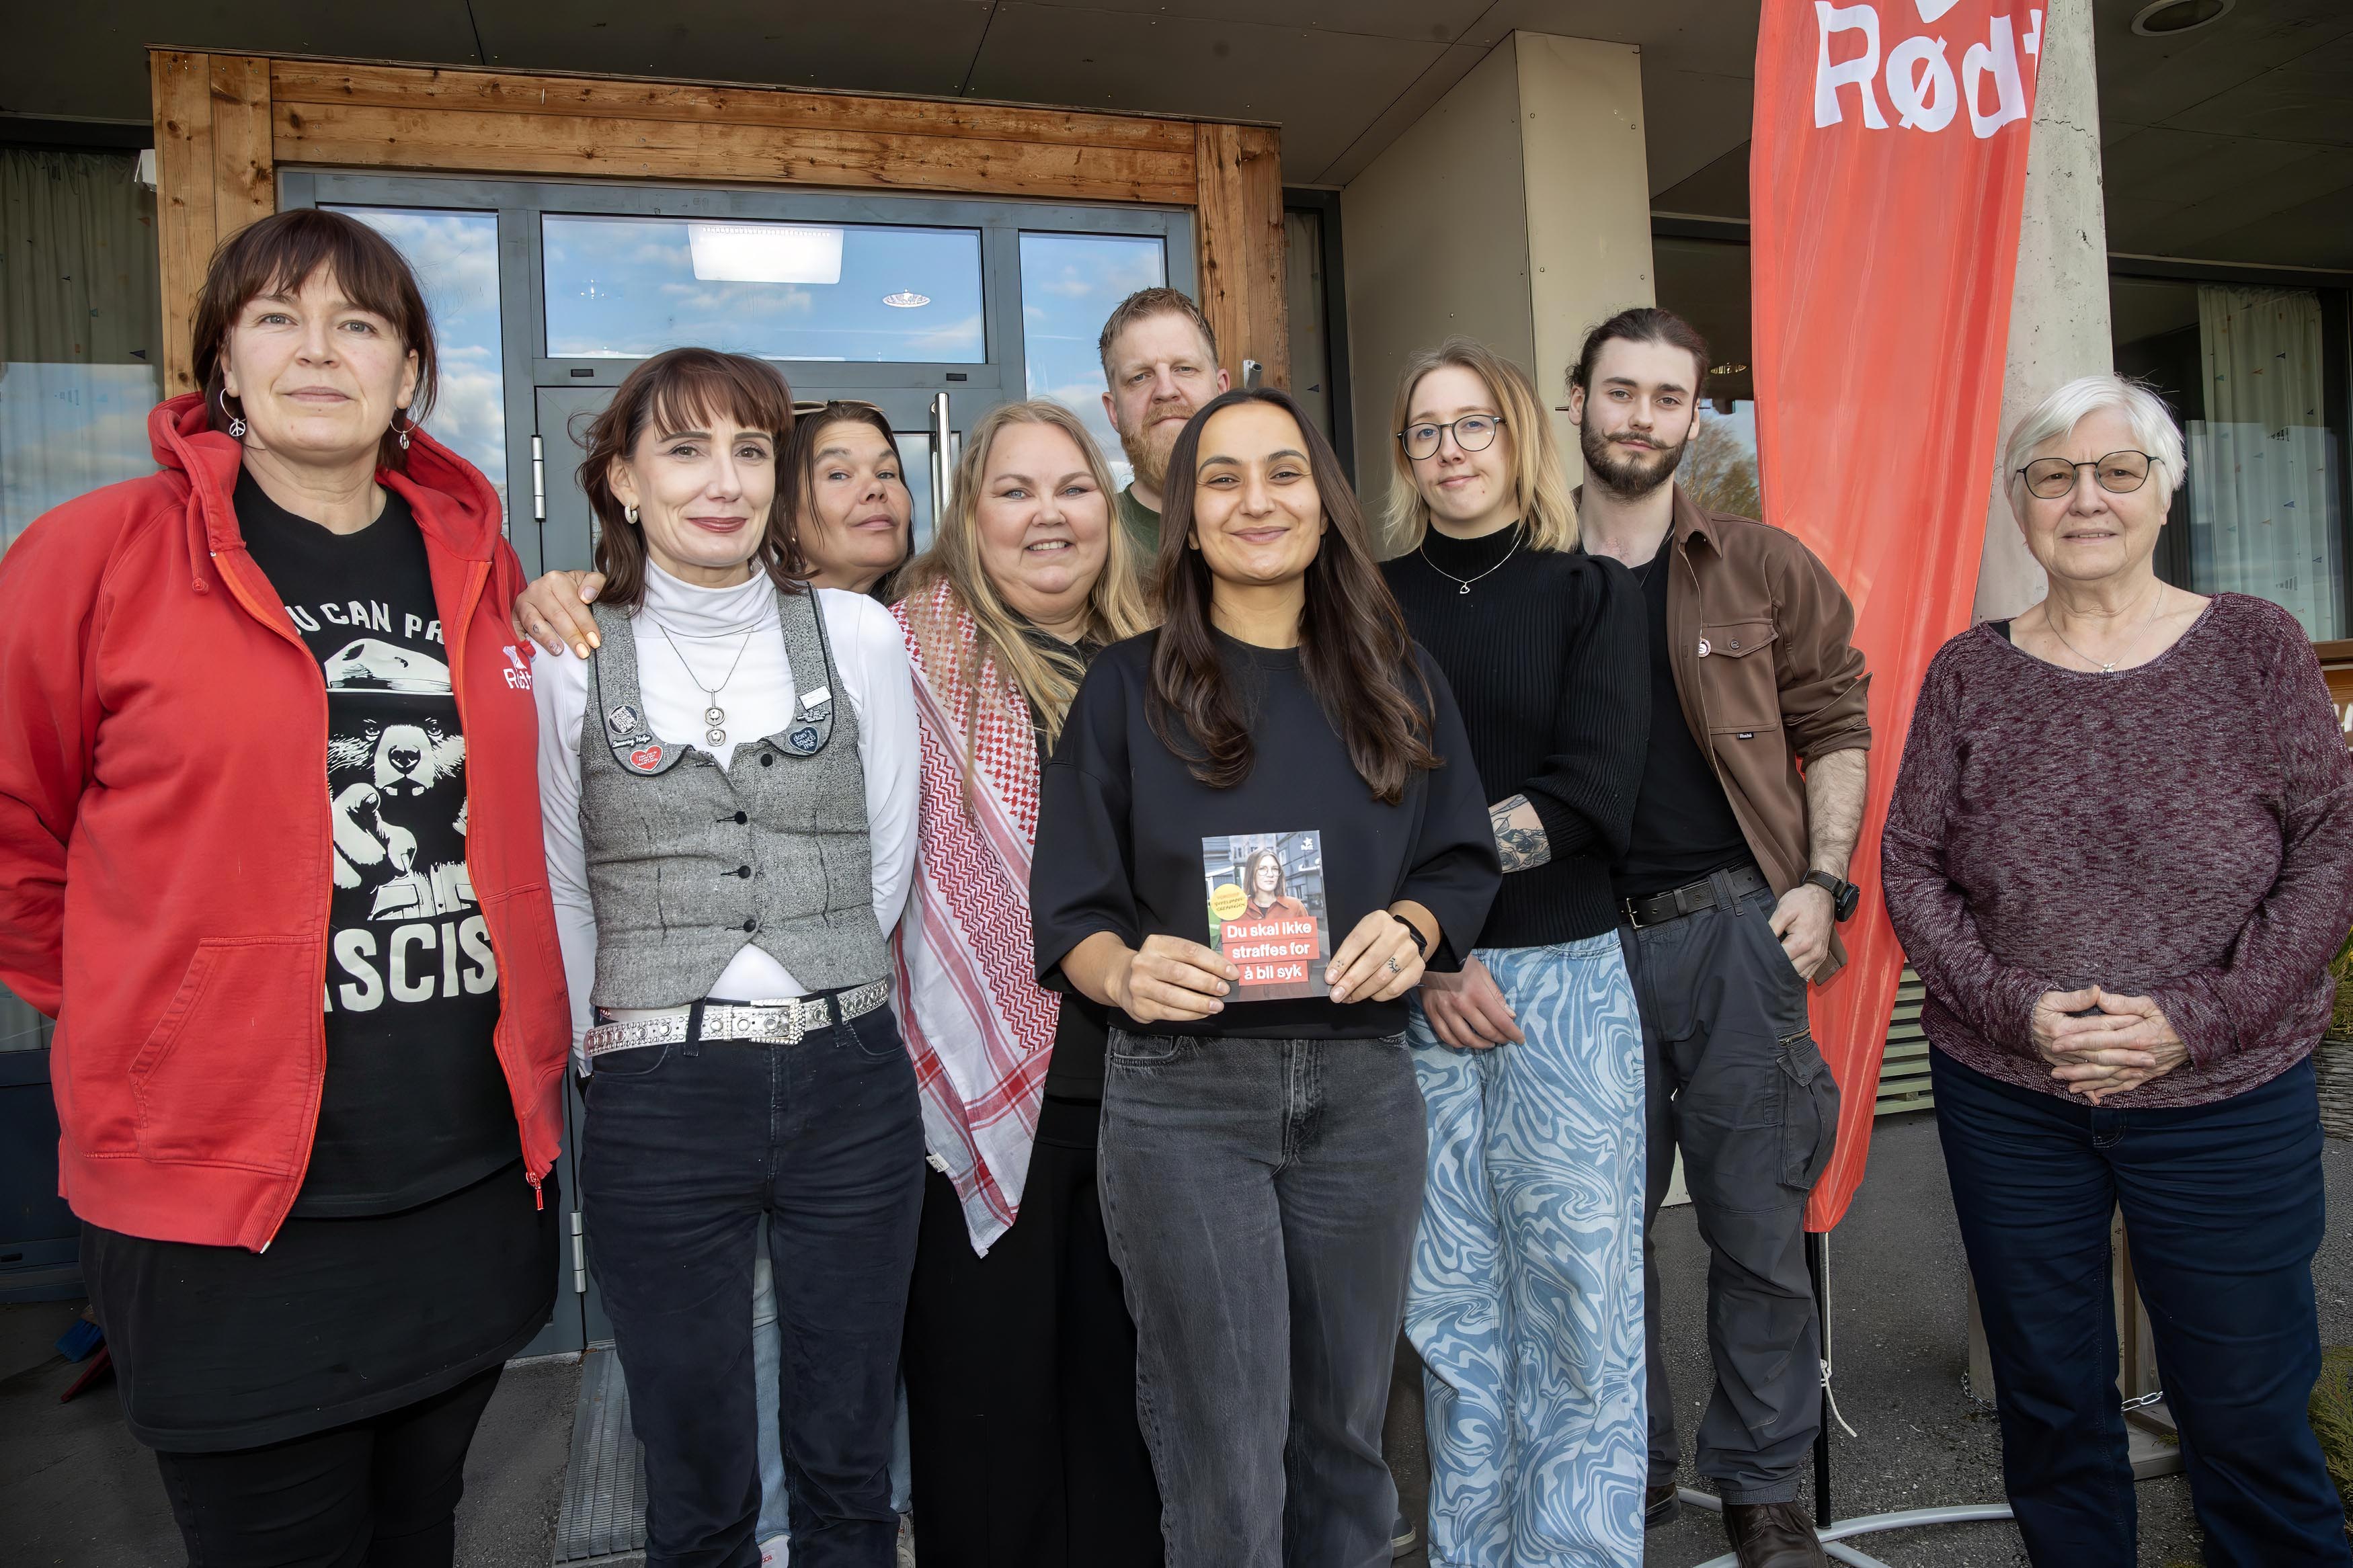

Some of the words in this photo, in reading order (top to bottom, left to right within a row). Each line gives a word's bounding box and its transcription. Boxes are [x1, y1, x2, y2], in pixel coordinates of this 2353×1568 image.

[284, 605, 321, 636] U
[319, 600, 391, 632] CAN
[1227, 925, 1247, 938] Du
[1250, 922, 1279, 937] skal
[1232, 944, 1287, 958] straffes
[1290, 942, 1310, 955] for
[323, 915, 497, 1012] SCIS
[1244, 966, 1254, 980] å
[1277, 964, 1302, 980] syk
